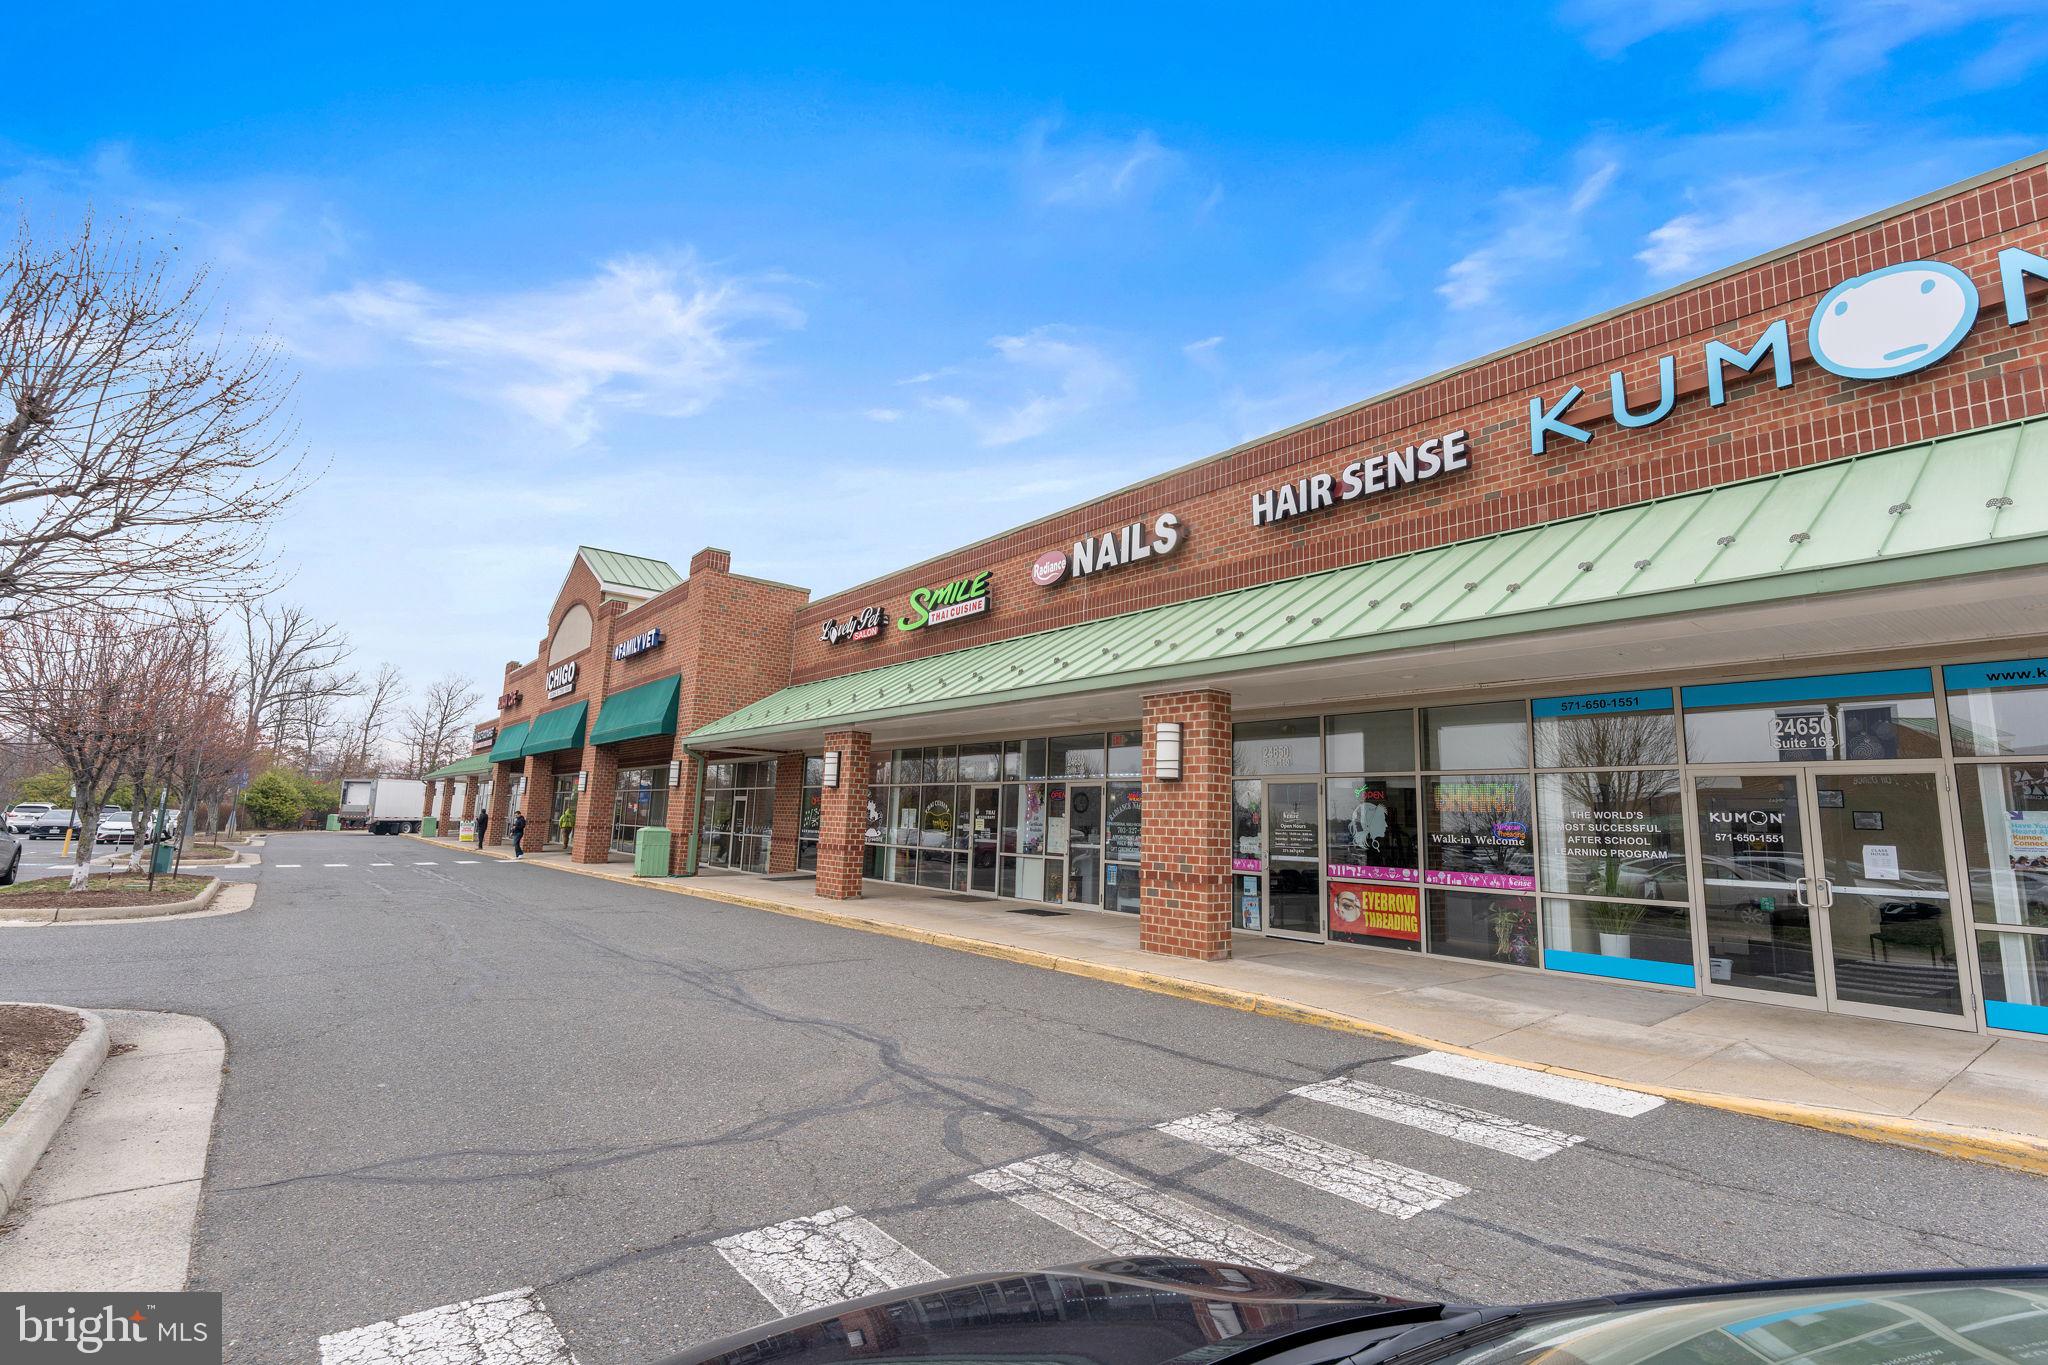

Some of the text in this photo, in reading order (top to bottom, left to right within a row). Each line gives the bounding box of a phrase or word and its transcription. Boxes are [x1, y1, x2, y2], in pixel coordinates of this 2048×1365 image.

[1252, 429, 1470, 527] HAIR SENSE
[1072, 512, 1180, 578] NAILS
[1033, 558, 1067, 580] Radiance
[897, 570, 993, 632] SMILE
[930, 599, 984, 623] THAI CUISINE
[819, 606, 882, 645] Lovely Pet
[854, 627, 879, 640] SALON
[618, 628, 656, 661] FAMILY VET
[546, 661, 576, 691] ICHIGO
[1561, 697, 1639, 712] 571-650-1551
[1775, 717, 1832, 736] 24650
[1774, 736, 1835, 749] Suite 165
[1361, 790, 1385, 800] OPEN
[1571, 811, 1644, 821] THE WORLD'S
[1709, 810, 1784, 826] KUMON
[1558, 823, 1662, 834] MOST SUCCESSFUL
[1432, 833, 1525, 847] Walk-in Welcome
[1567, 835, 1651, 846] AFTER SCHOOL
[1715, 833, 1785, 843] 571-650-1551
[1554, 847, 1669, 860] LEARNING PROGRAM
[1362, 891, 1416, 914] EYEBROW
[1364, 912, 1418, 932] THREADING
